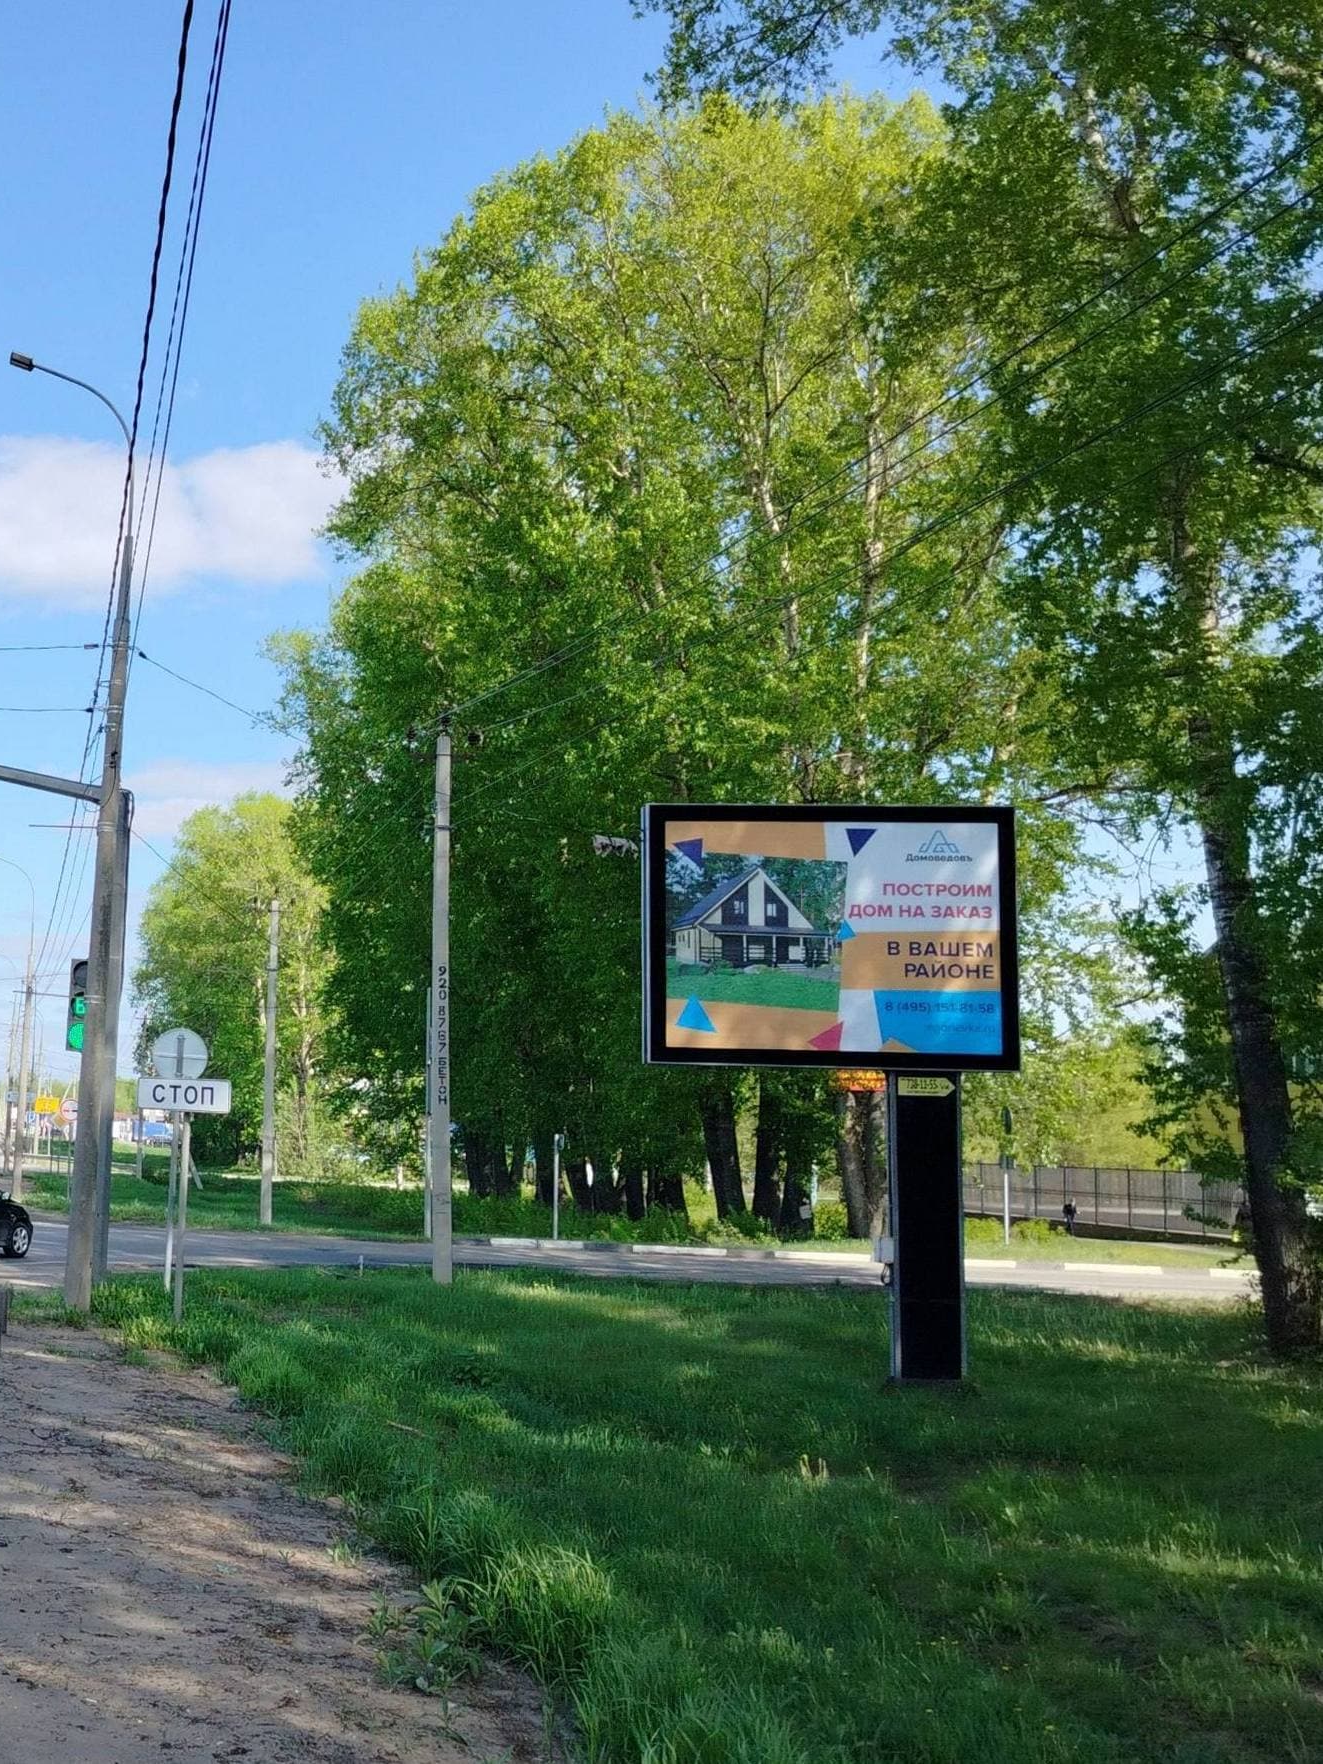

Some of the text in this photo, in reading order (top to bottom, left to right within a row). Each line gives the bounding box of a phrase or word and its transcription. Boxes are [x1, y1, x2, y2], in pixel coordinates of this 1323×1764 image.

[905, 853, 973, 863] Домоведовъ
[882, 883, 992, 897] ПОСТРОИМ
[848, 904, 992, 919] ДОМ НА ЗАКАЗ
[887, 941, 993, 957] В ВАШЕМ
[904, 960, 994, 979] РАЙОНЕ
[438, 965, 447, 1001] 920
[884, 1001, 894, 1012] 8
[897, 1001, 931, 1014] (495)
[438, 1057, 447, 1105] БЕТОН
[152, 1084, 214, 1105] СТОП
